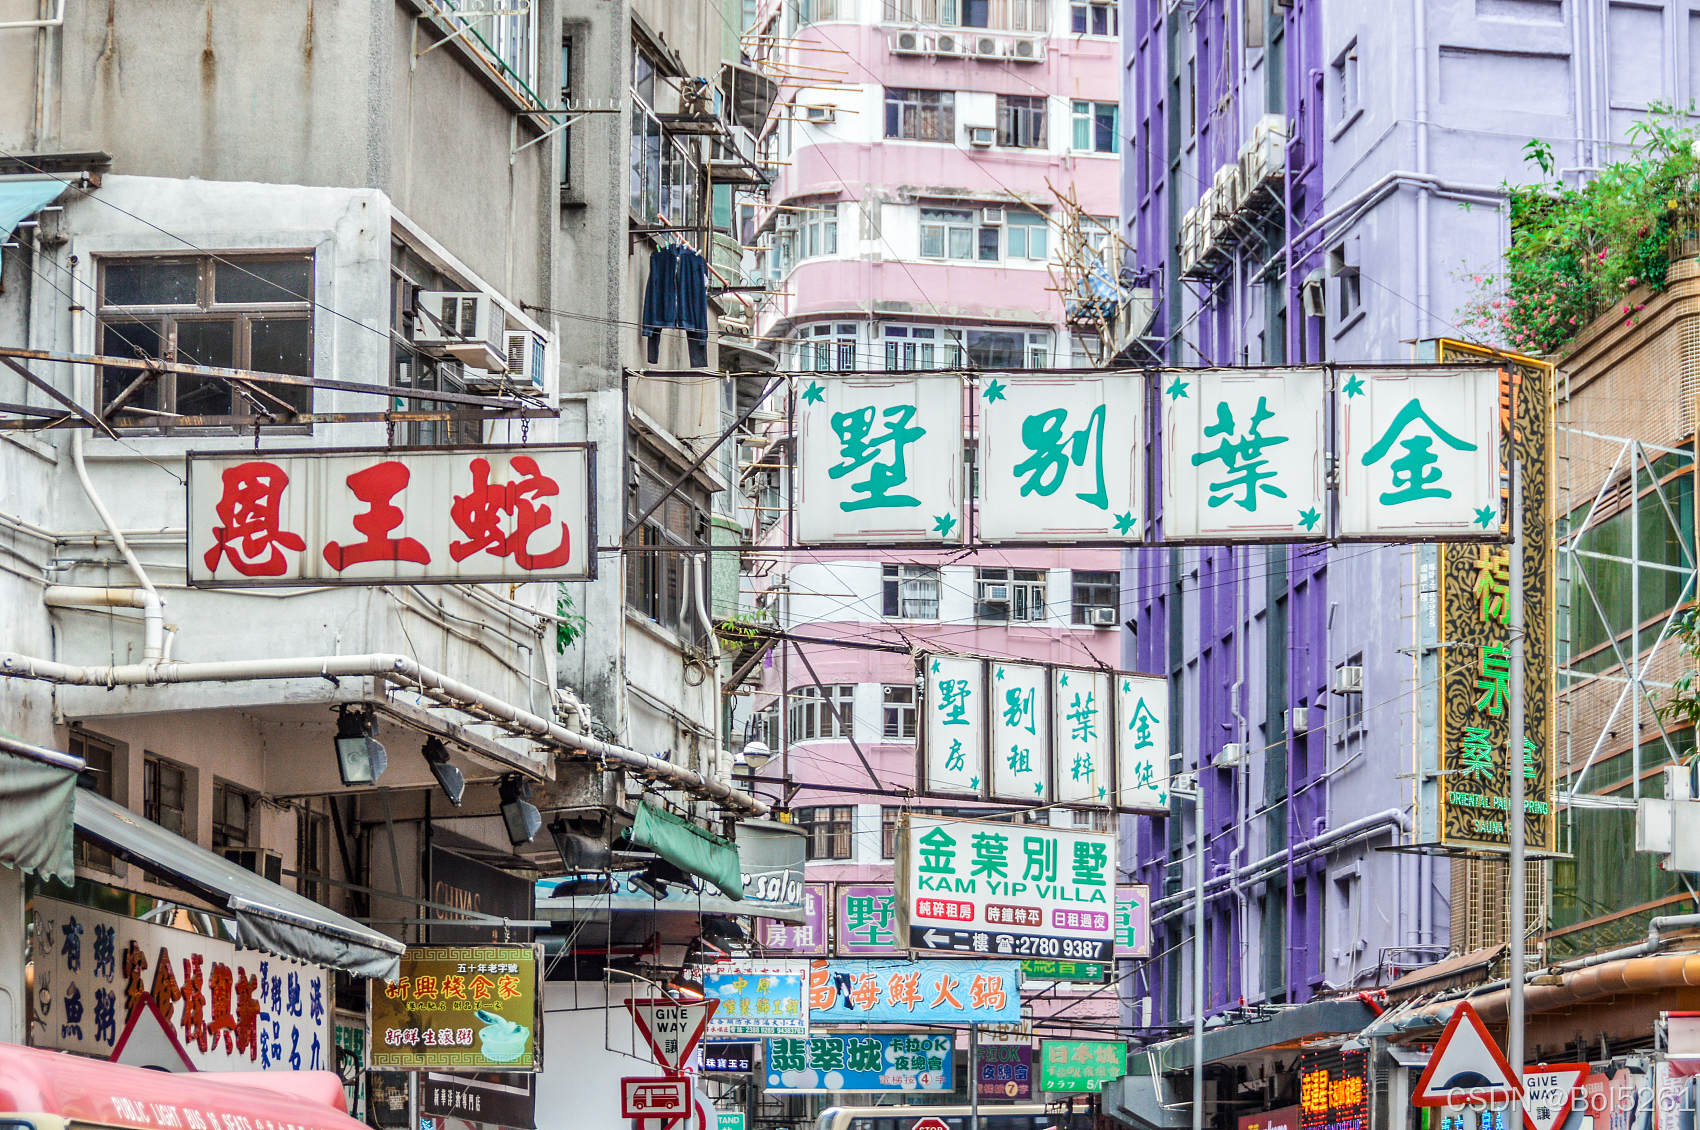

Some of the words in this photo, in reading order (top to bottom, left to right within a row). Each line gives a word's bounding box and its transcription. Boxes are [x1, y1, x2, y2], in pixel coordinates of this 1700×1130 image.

[1449, 791, 1491, 809] ORIENTAL
[1524, 800, 1549, 815] PRING
[1473, 820, 1504, 835] SAUNA
[918, 827, 1107, 887] 金葉別墅
[918, 875, 976, 894] KAM
[986, 880, 1027, 897] YIP
[1036, 884, 1107, 904] VILLA
[919, 900, 972, 919] 純碎租房
[988, 906, 1040, 923] 時鐘特平
[847, 895, 894, 946] 墅
[1055, 911, 1106, 929] 日租過夜
[953, 932, 989, 953] 二樓
[1063, 940, 1103, 958] 9387
[457, 963, 519, 974] 五十年老字號
[385, 975, 522, 1000] 新興棧食家
[732, 976, 772, 996] 中原
[655, 1008, 688, 1020] GIVE
[657, 1022, 688, 1033] WAY
[665, 1039, 678, 1054] 讓
[889, 1038, 948, 1053] 卡拉OK
[1049, 1043, 1119, 1065] 日本城
[772, 1037, 883, 1072] 翡翠城
[895, 1055, 943, 1071] 夜總會
[1527, 1076, 1558, 1088] GIVE
[1529, 1089, 1557, 1100] WAY
[111, 1097, 150, 1123] PUBLIC
[150, 1103, 182, 1128] LIGHT
[183, 1108, 207, 1130] BUS
[717, 1116, 740, 1124] TAND
[1536, 1106, 1551, 1121] 讓
